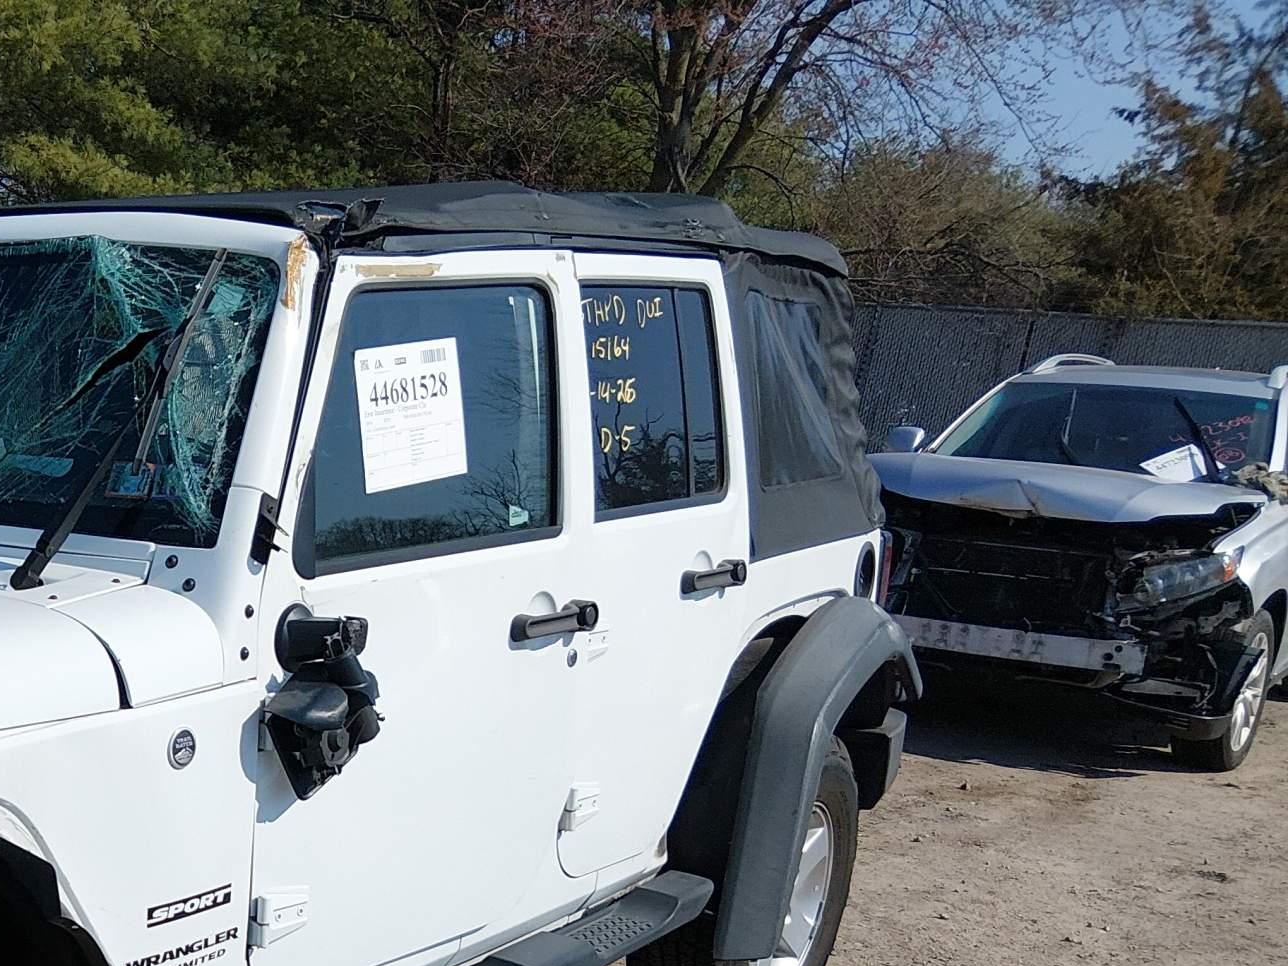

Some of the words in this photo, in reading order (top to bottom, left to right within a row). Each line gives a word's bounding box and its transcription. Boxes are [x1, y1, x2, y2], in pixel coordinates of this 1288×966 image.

[636, 296, 664, 329] DUI
[591, 335, 630, 361] 15164
[368, 370, 449, 408] 44681528
[599, 425, 636, 453] D-5
[151, 889, 231, 921] SPORT
